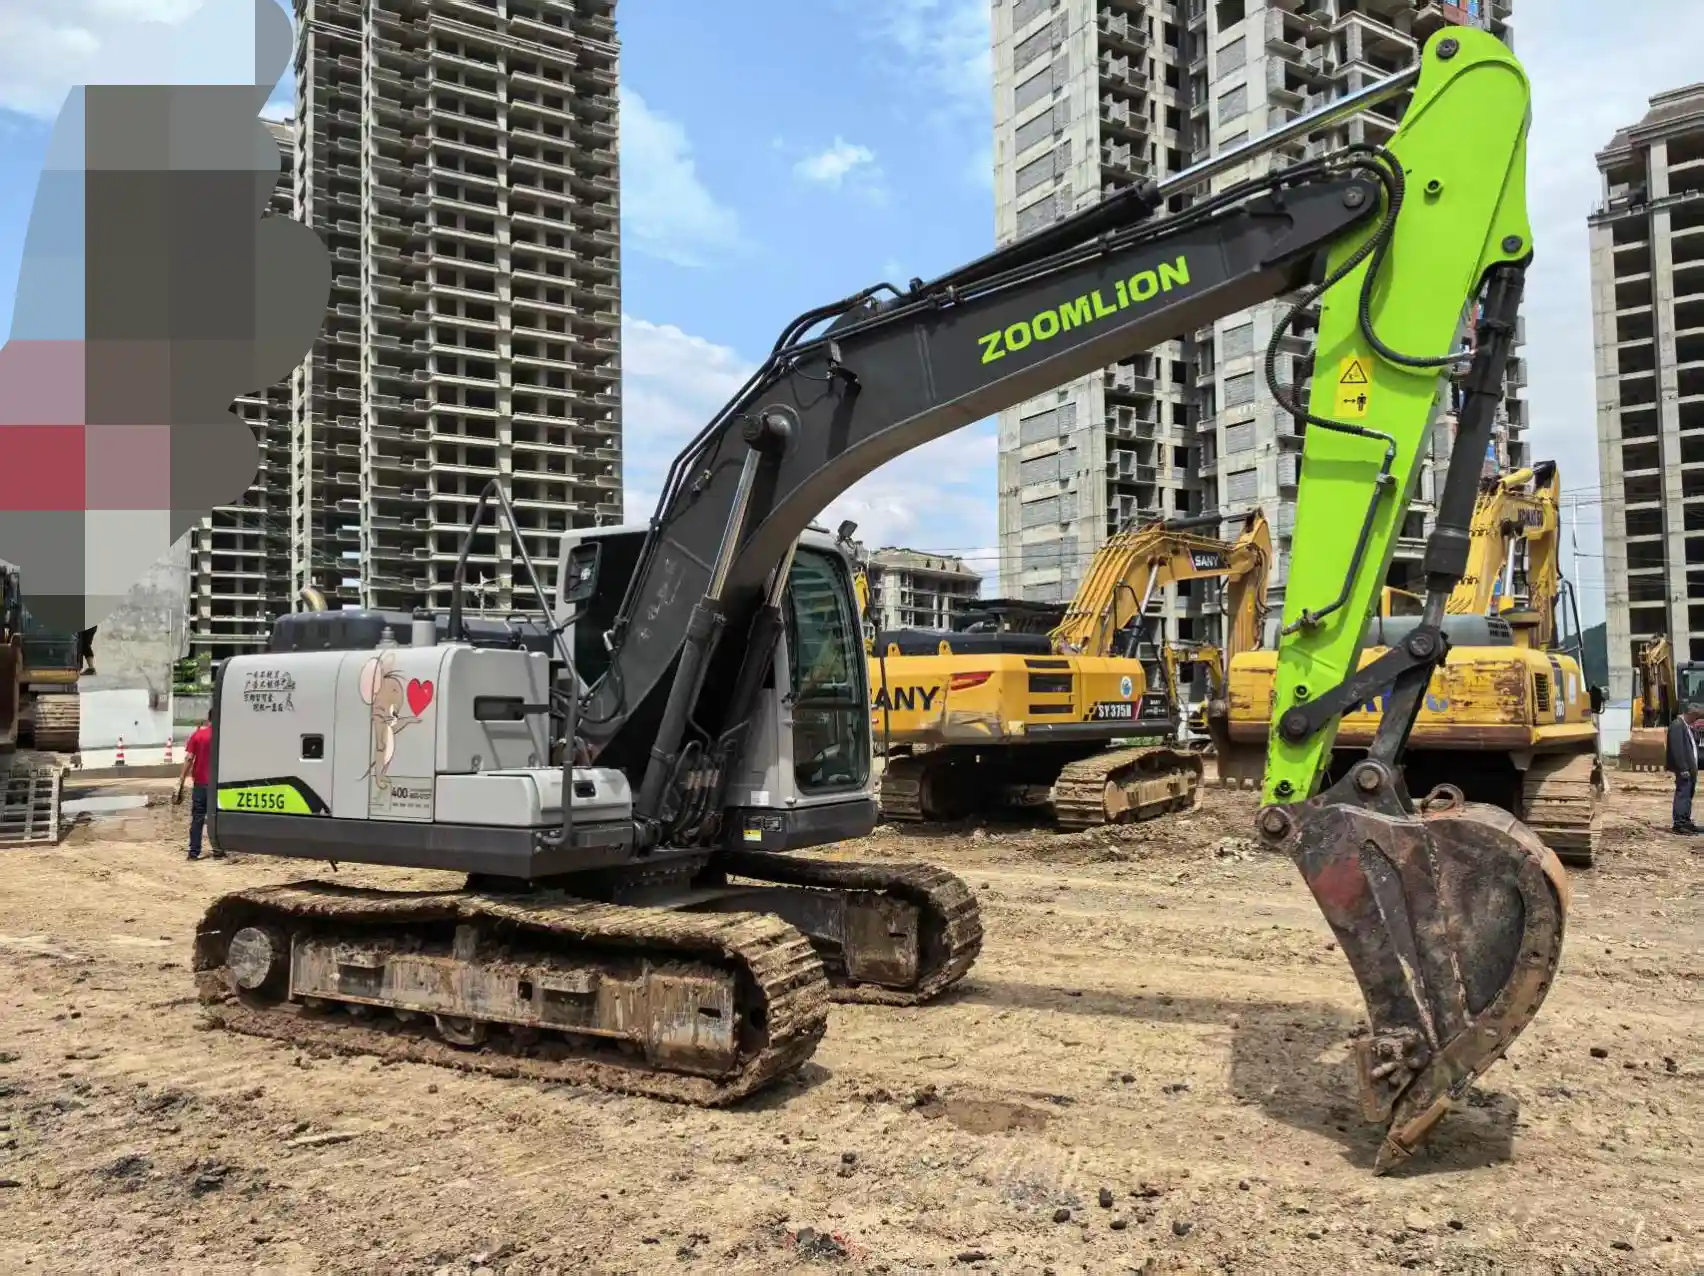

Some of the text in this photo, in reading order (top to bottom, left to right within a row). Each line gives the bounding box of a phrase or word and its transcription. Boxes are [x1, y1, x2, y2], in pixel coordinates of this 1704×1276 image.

[1194, 555, 1219, 567] SANY
[870, 686, 940, 711] ANY
[237, 792, 285, 809] ZE155G
